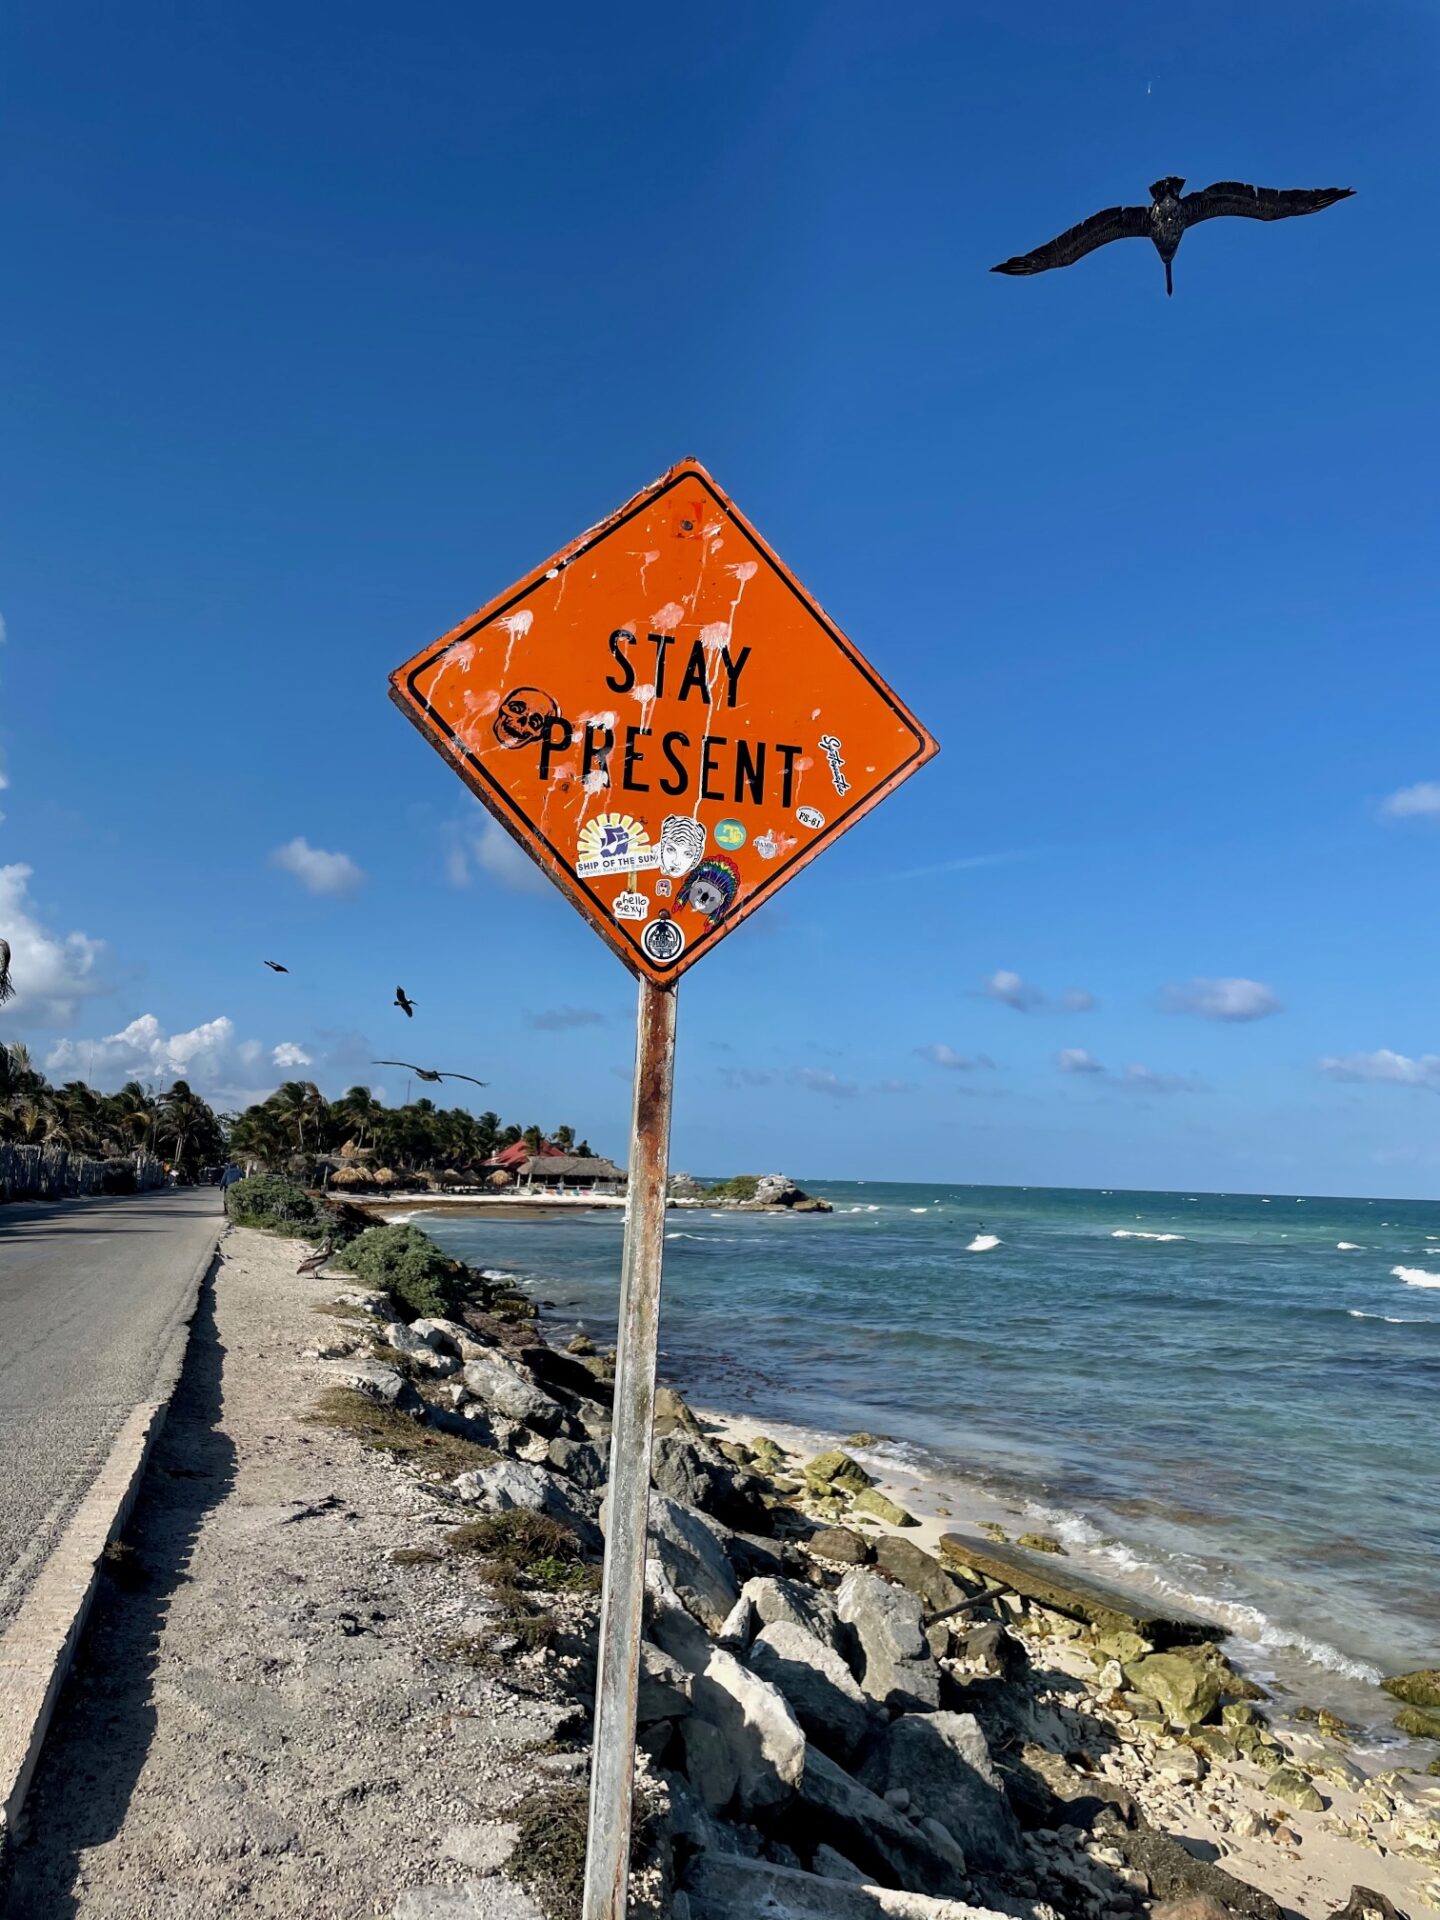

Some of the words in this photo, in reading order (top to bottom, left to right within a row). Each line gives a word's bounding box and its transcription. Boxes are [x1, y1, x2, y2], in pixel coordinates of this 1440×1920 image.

[606, 629, 751, 707] STAY
[539, 717, 802, 807] PRESENT
[578, 861, 598, 871] SHIP
[602, 859, 616, 868] OF
[618, 856, 635, 866] THE
[638, 855, 655, 864] SUN
[622, 894, 647, 906] hello
